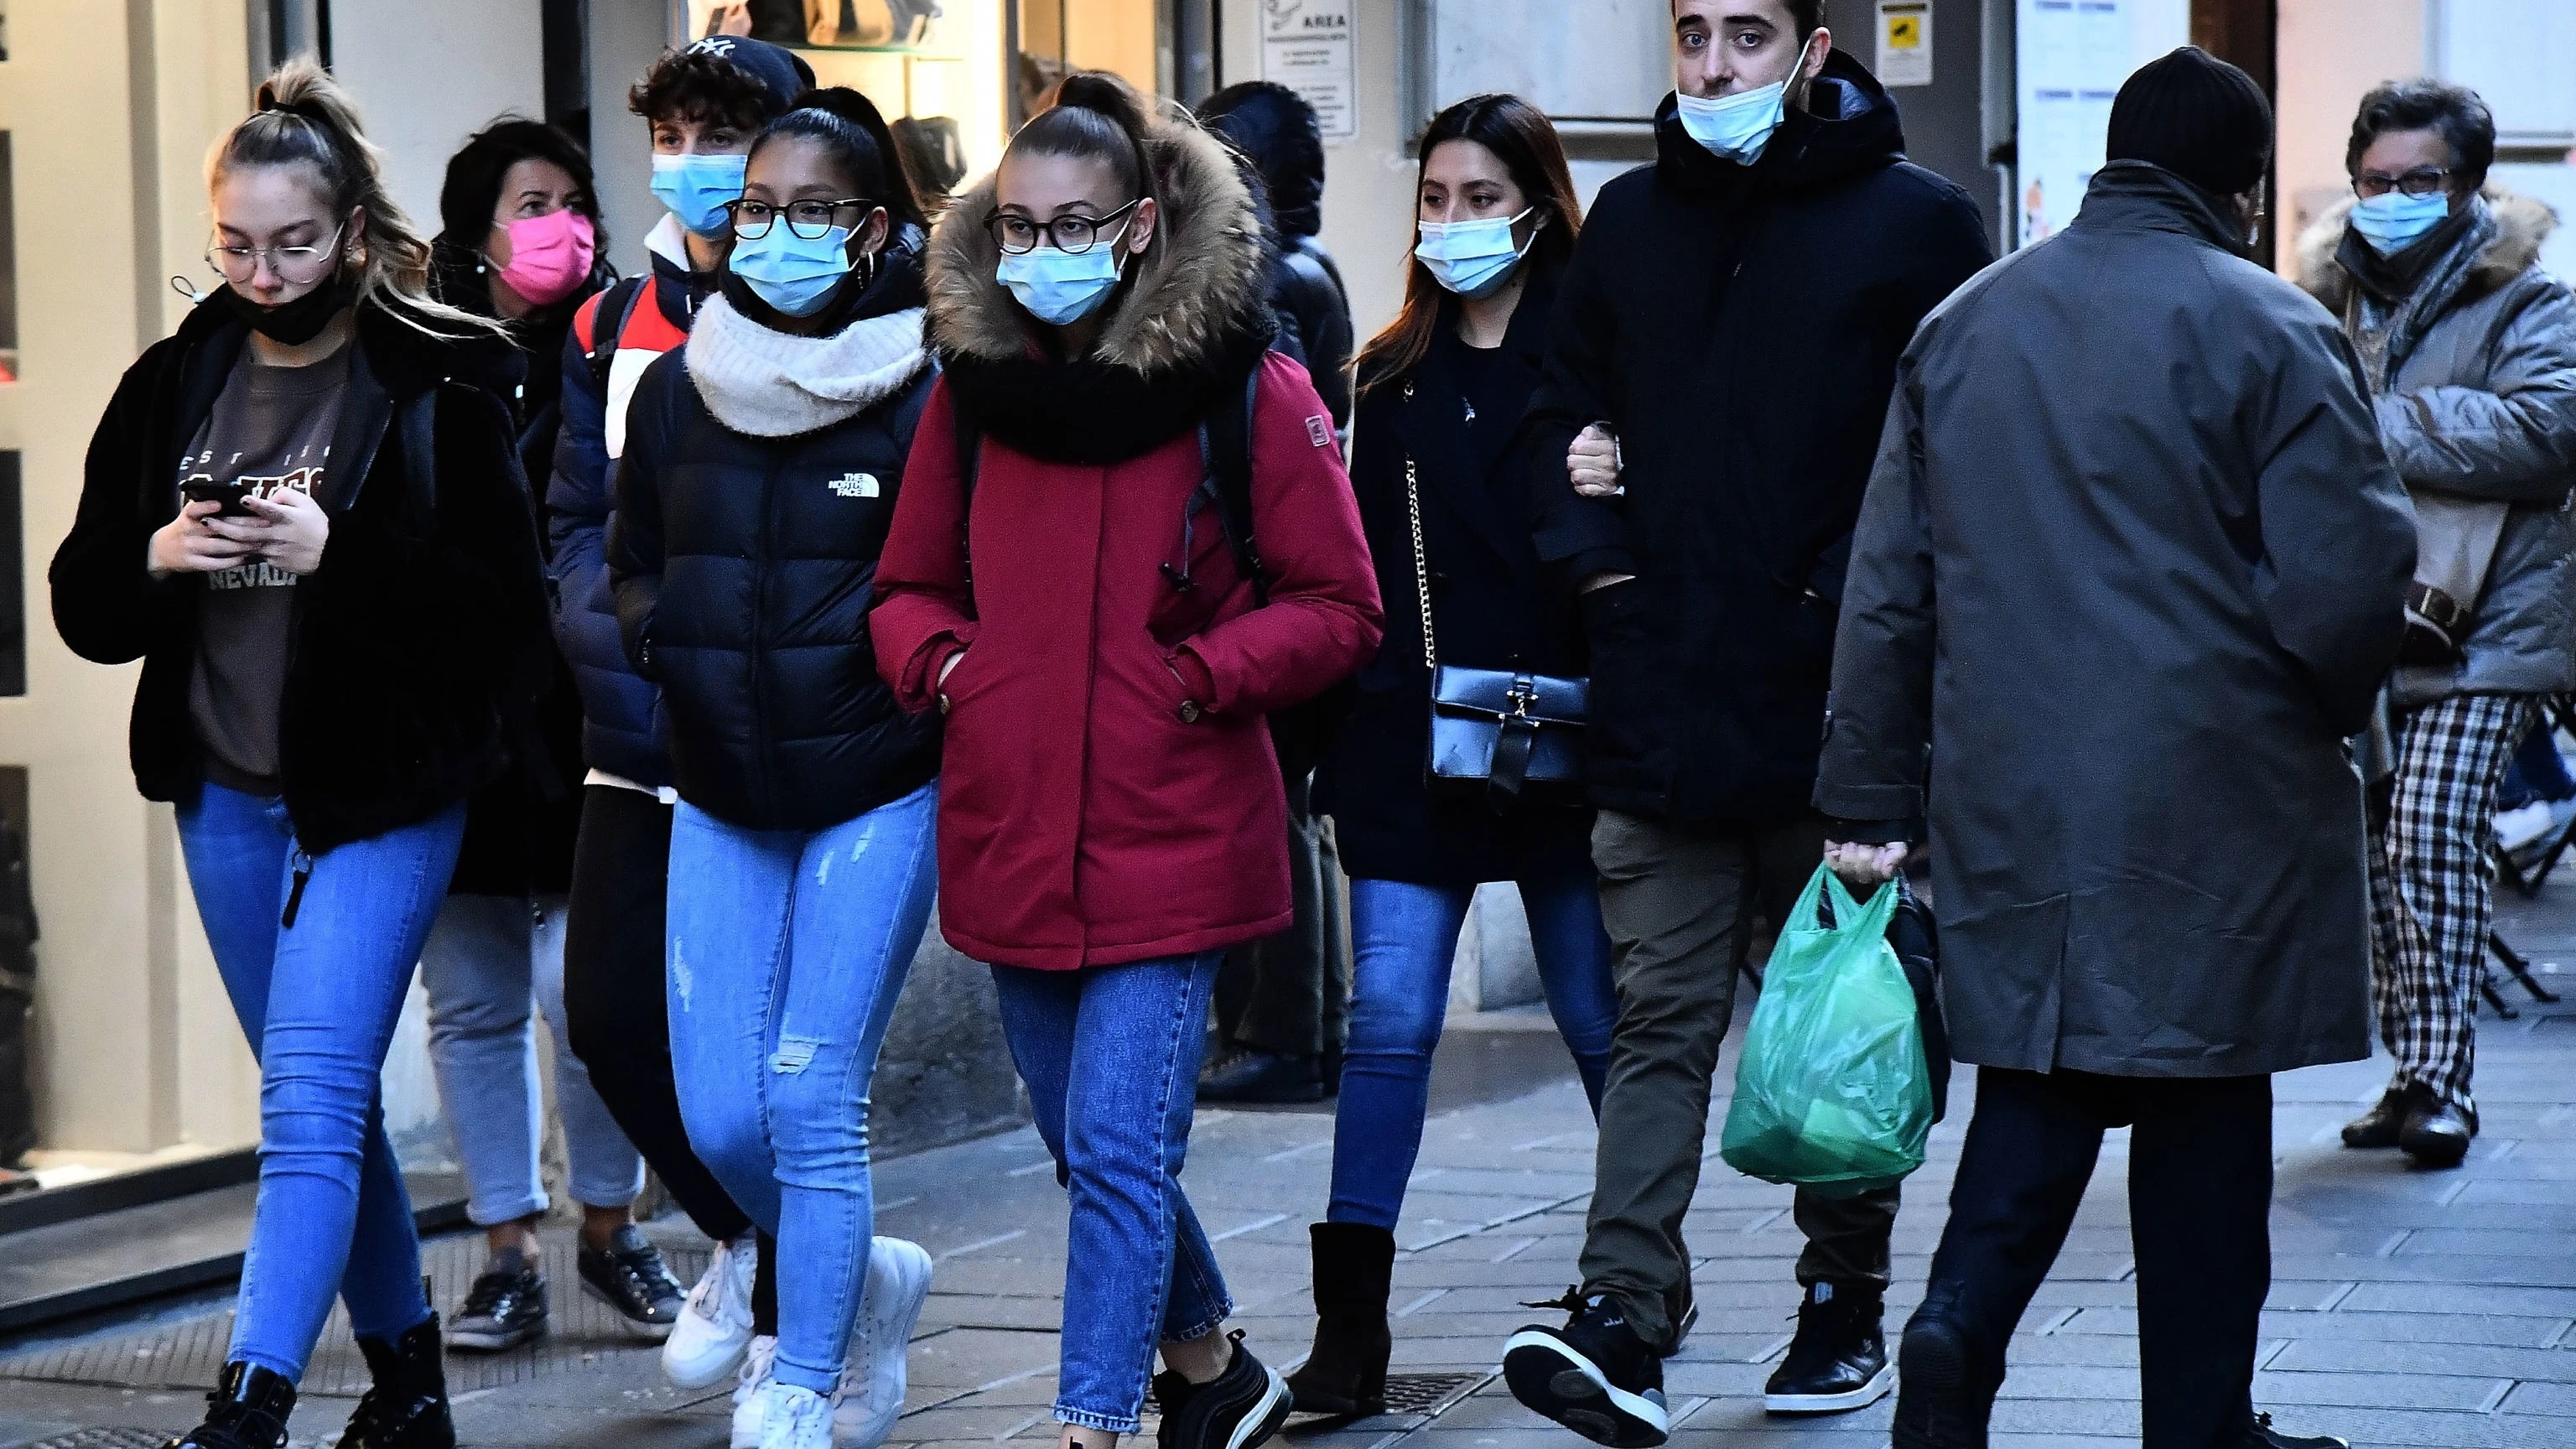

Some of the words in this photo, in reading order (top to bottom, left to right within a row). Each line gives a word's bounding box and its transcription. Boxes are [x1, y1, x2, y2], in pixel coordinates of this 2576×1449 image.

[1303, 15, 1346, 28] AREA
[844, 473, 864, 481] THE
[828, 480, 863, 489] NORTH
[837, 489, 862, 497] FACE
